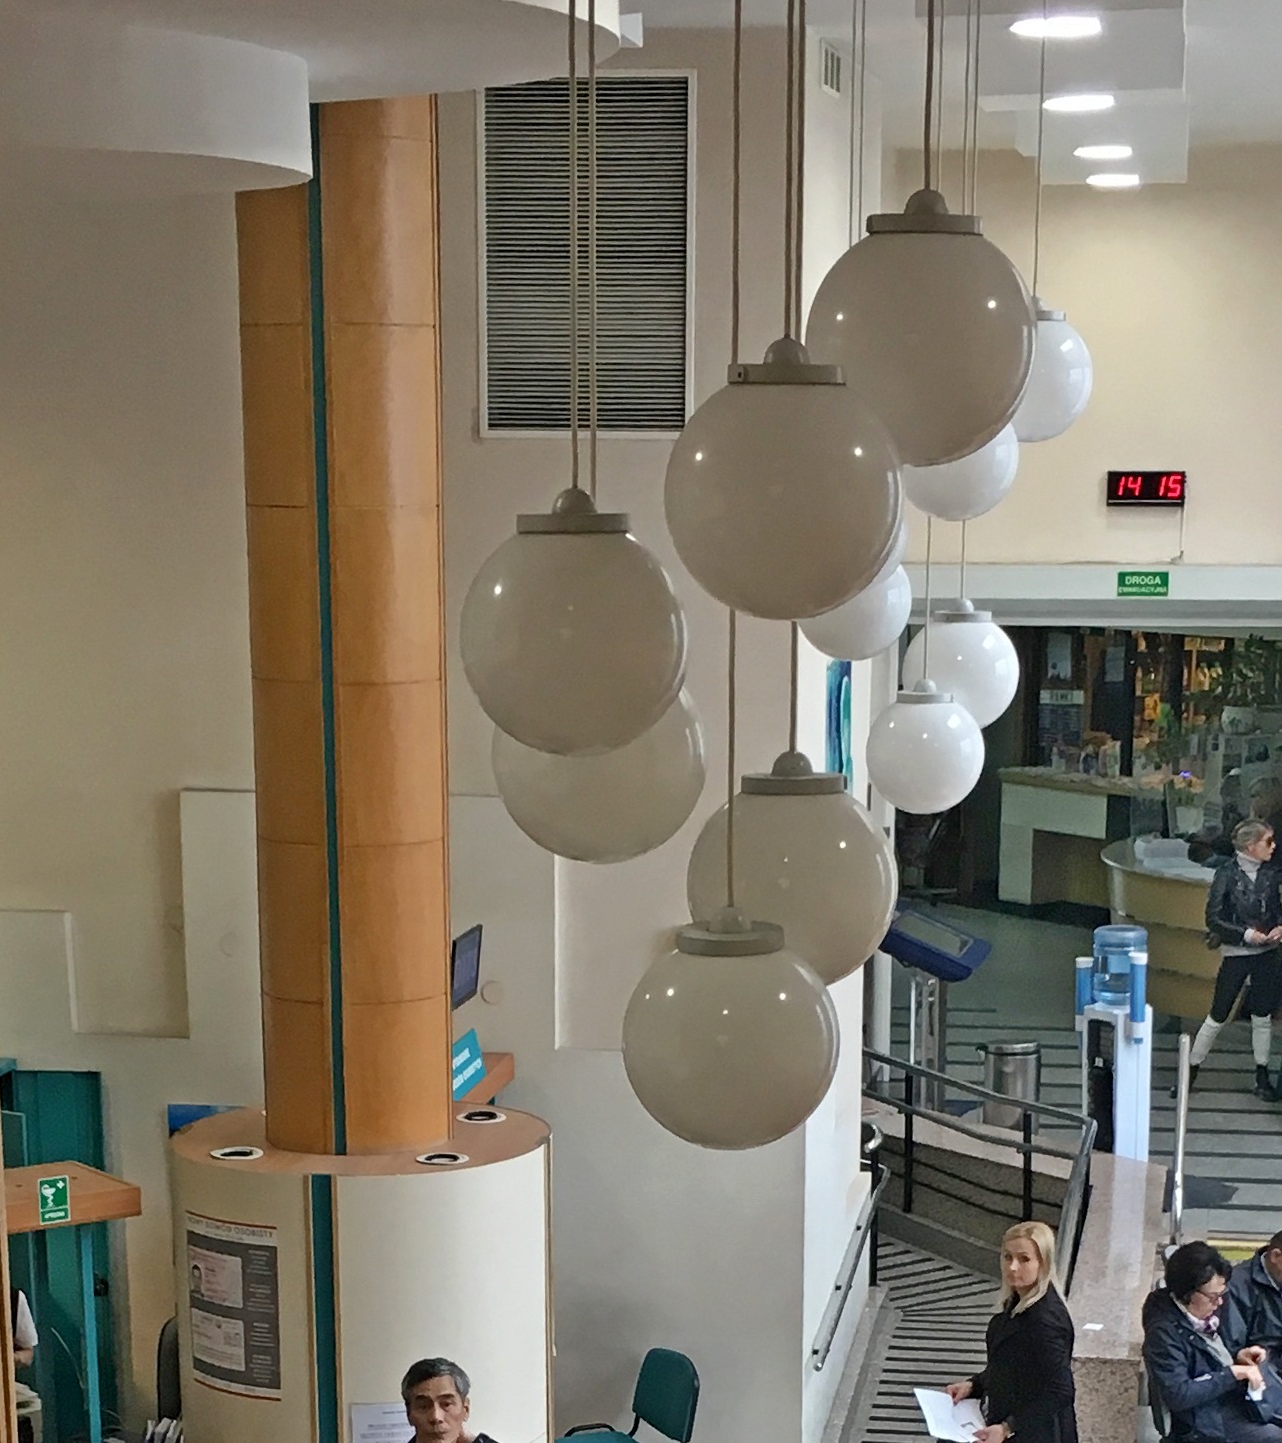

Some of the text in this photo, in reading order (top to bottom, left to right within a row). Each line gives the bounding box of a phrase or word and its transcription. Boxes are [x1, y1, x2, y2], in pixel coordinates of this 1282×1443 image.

[1117, 475, 1183, 497] 14 15
[1125, 575, 1162, 585] DROGA
